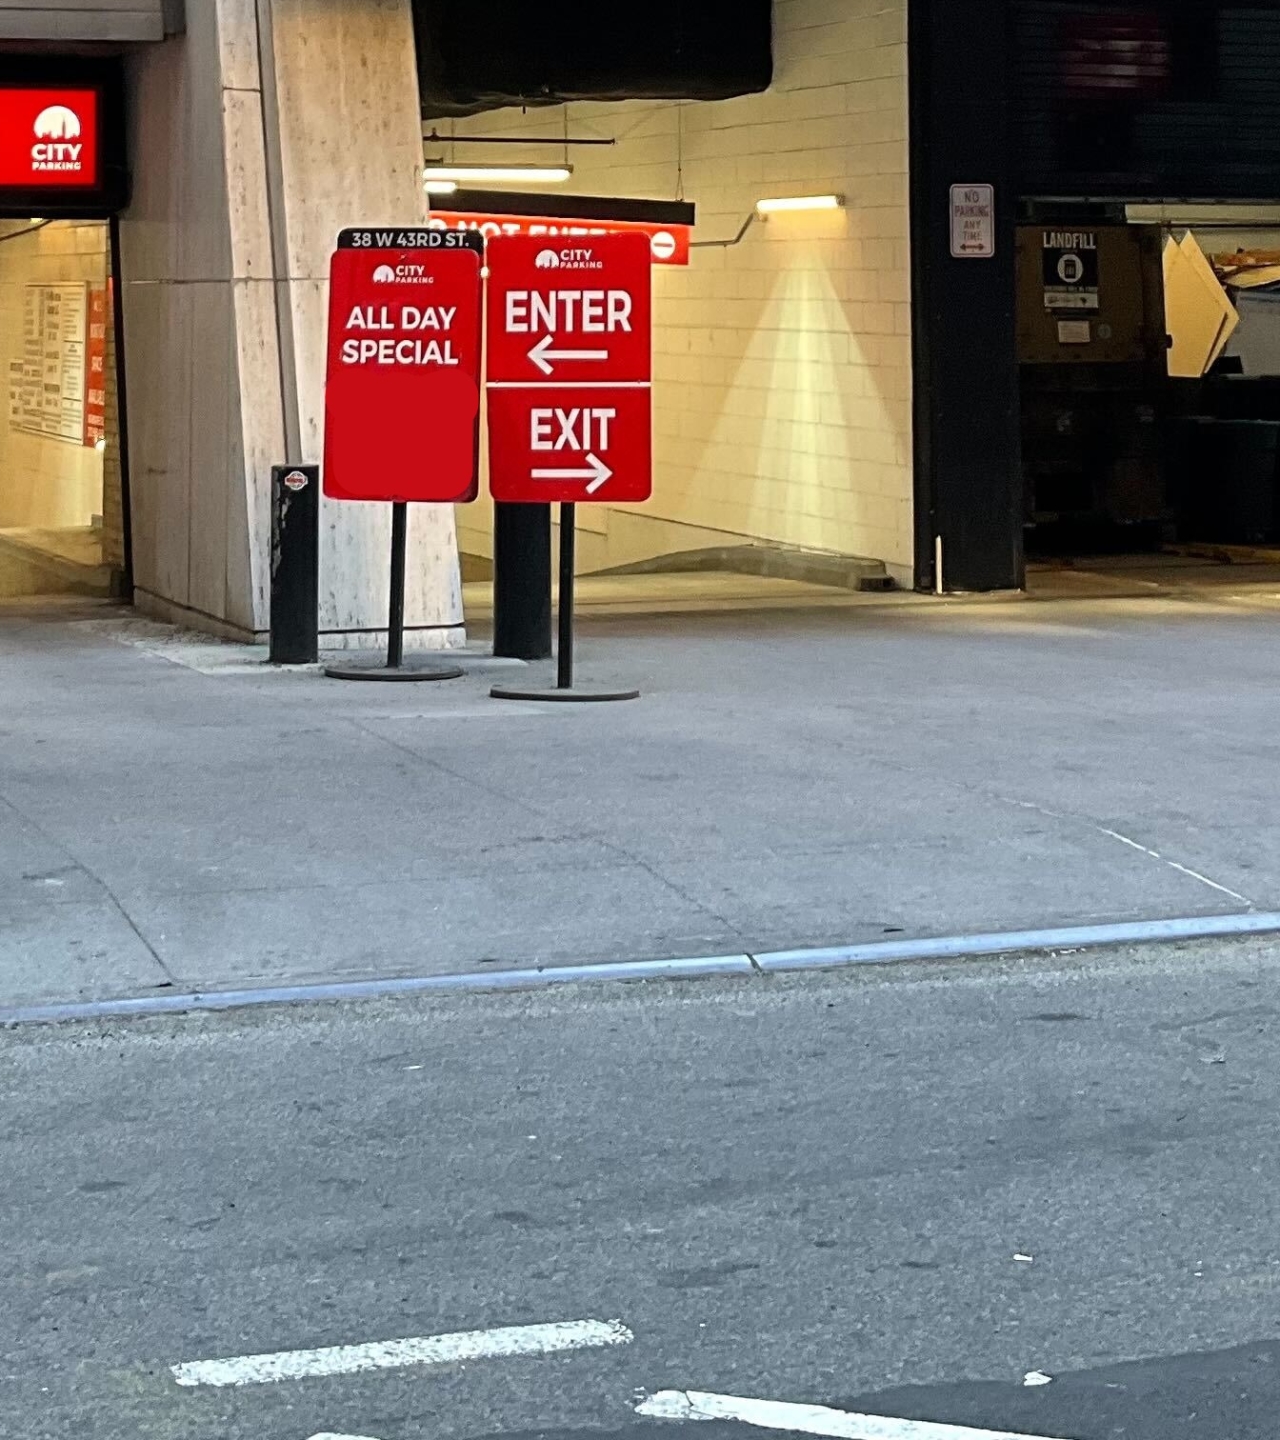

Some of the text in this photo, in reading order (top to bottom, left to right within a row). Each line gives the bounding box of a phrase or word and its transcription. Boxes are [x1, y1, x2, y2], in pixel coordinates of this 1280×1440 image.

[31, 143, 82, 161] CITY
[31, 161, 81, 171] PARKING
[964, 190, 980, 203] NO
[963, 220, 981, 230] ANY
[351, 232, 470, 247] 38 W 43RD ST.
[1043, 232, 1097, 249] LANDFILL
[560, 249, 593, 261] CITY
[395, 265, 425, 276] CITY
[560, 261, 603, 269] PARKING
[394, 276, 434, 284] PARKING
[345, 306, 457, 331] ALL DAY
[505, 290, 632, 333] ENTER
[342, 339, 459, 365] SPECIAL
[530, 408, 616, 451] EXIT
